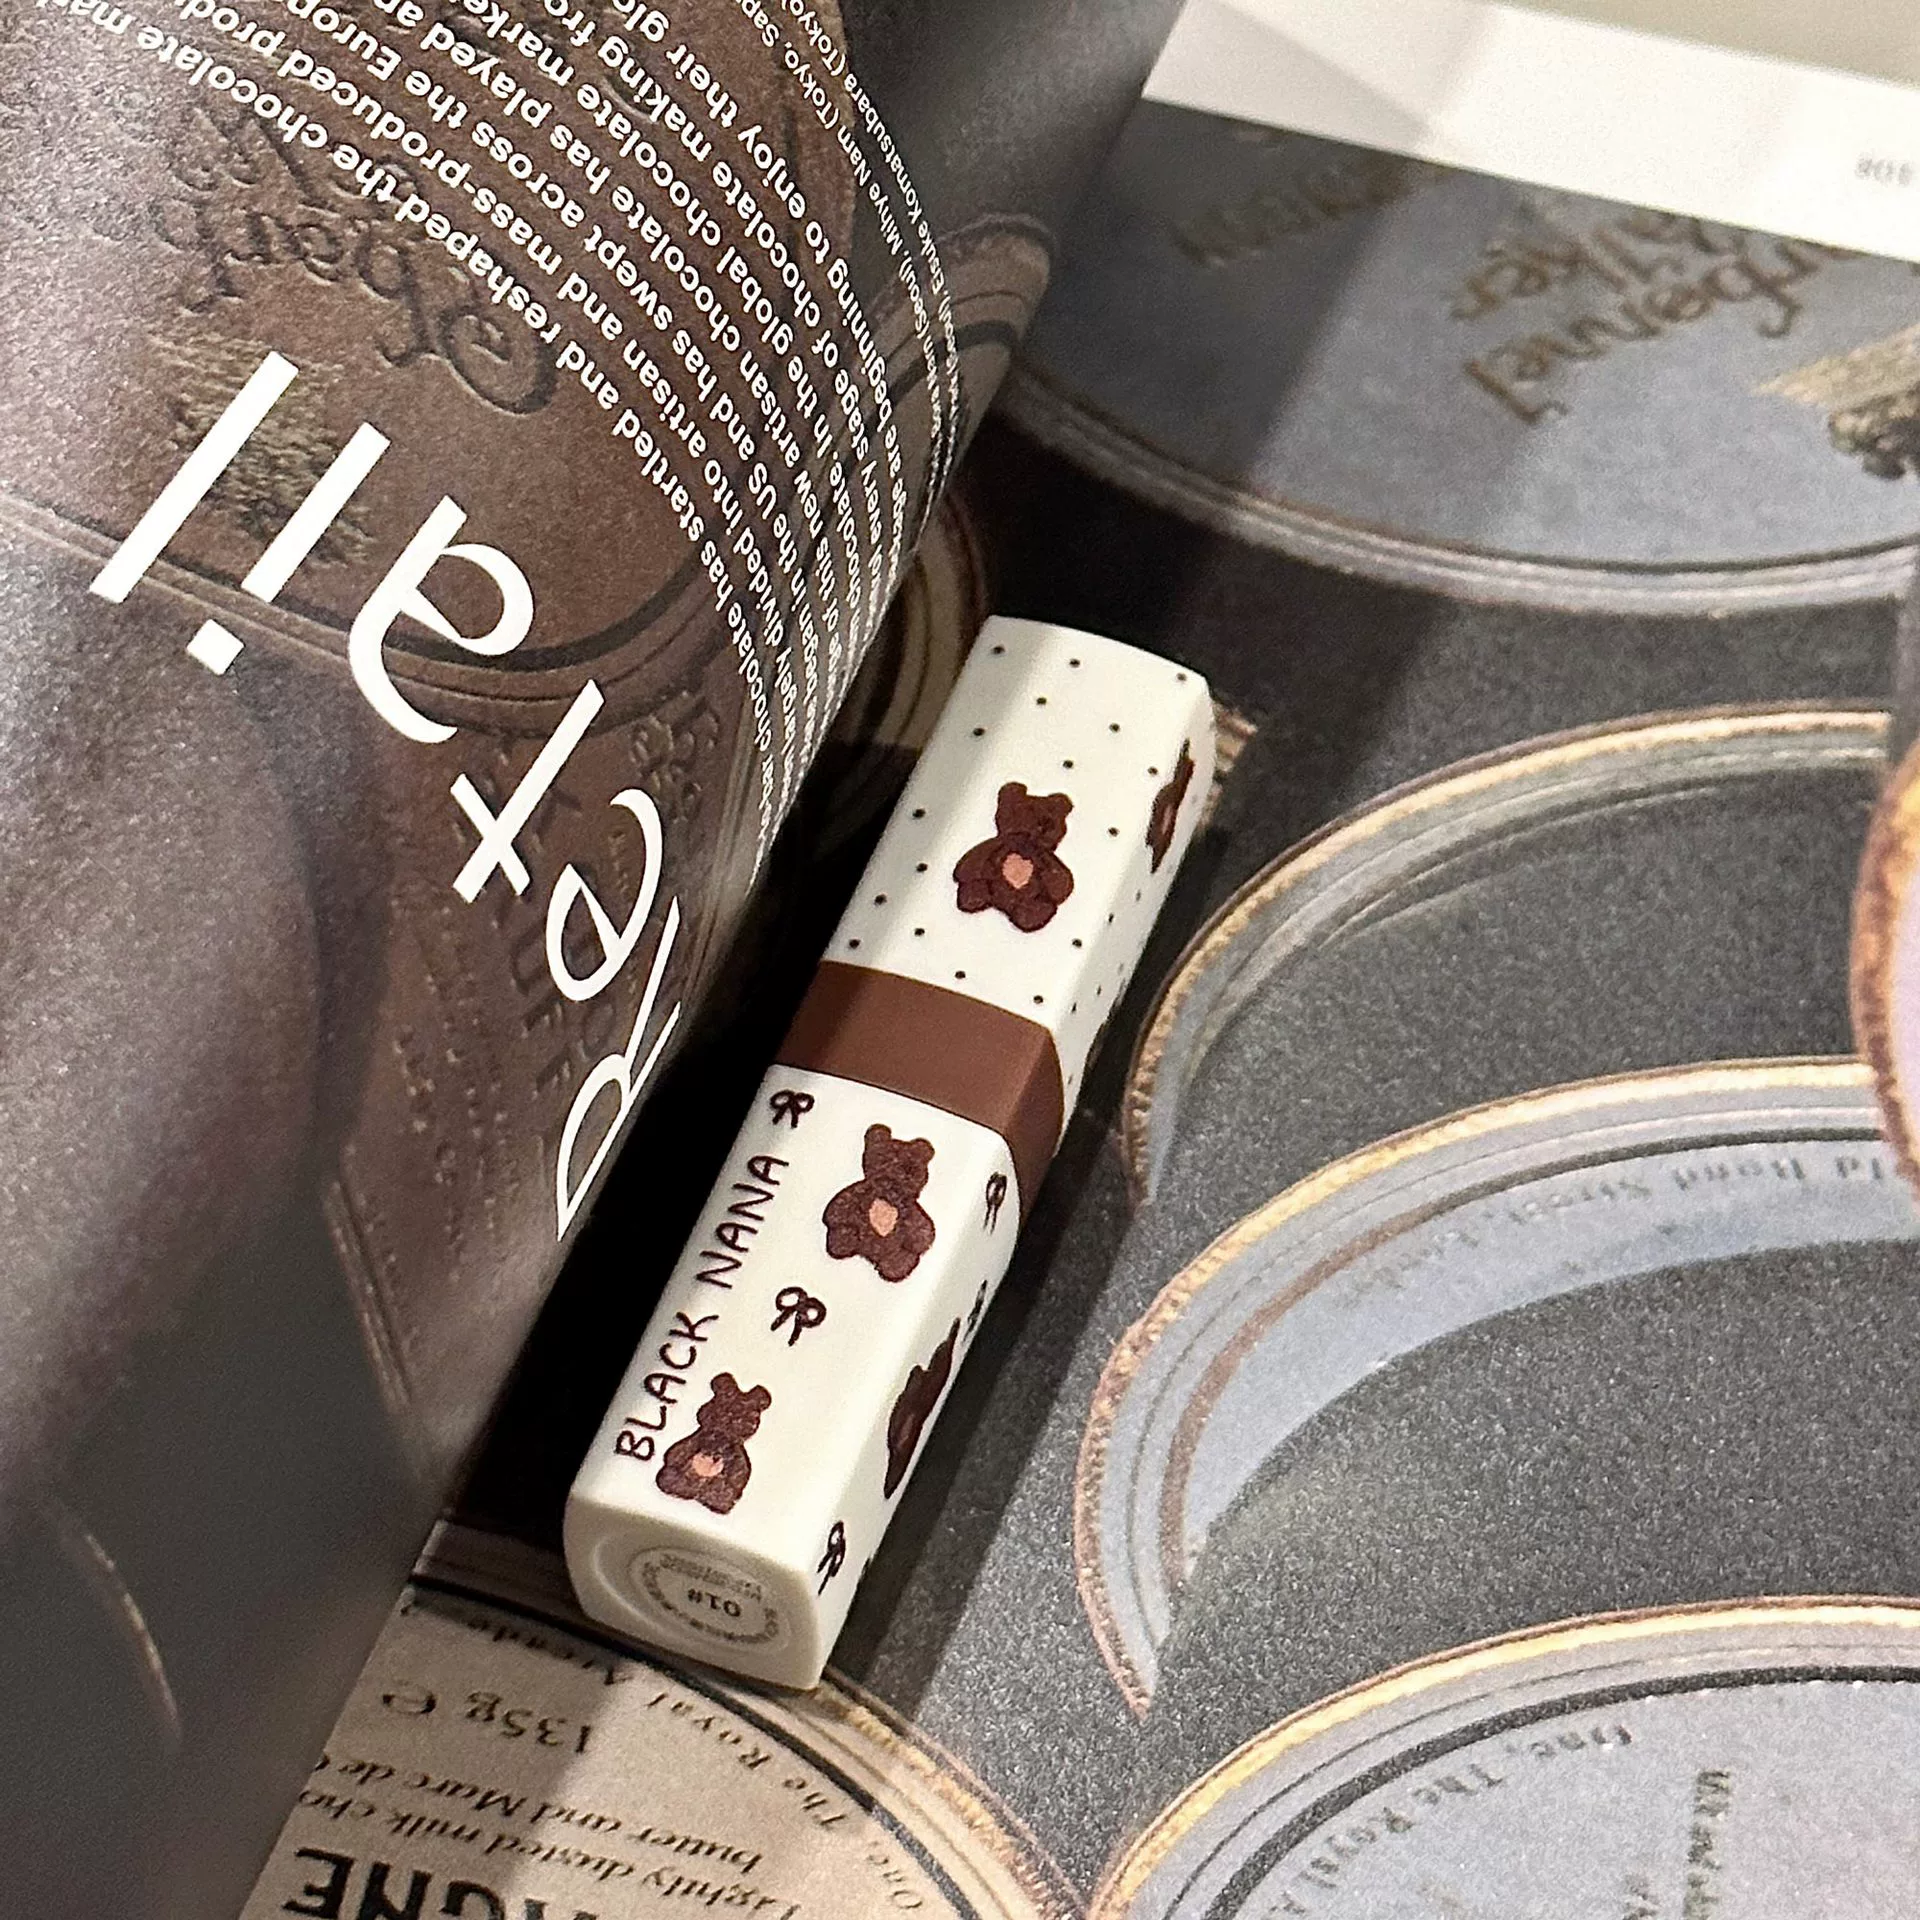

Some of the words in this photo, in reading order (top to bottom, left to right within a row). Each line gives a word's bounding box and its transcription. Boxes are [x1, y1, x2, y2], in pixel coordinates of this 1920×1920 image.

[176, 0, 286, 56] prod
[450, 0, 575, 86] marke
[737, 0, 779, 47] Sap
[138, 26, 327, 147] chocolate
[406, 71, 467, 128] the
[420, 23, 552, 127] played
[598, 36, 711, 161] making
[667, 45, 737, 127] their
[277, 49, 564, 275] mass-produced
[326, 144, 397, 202] the
[472, 122, 584, 227] across
[550, 125, 610, 194] has
[578, 84, 720, 245] chocolate
[738, 126, 805, 218] enjoy
[838, 125, 871, 185] Nam
[845, 74, 922, 224] Komatsubara
[713, 162, 819, 326] chocolate
[806, 222, 829, 264] to
[870, 183, 902, 254] Mihye
[393, 193, 561, 343] reshaped
[584, 225, 672, 330] swept
[613, 186, 739, 350] chocolate
[917, 220, 946, 295] Eisuke
[557, 273, 622, 340] and
[717, 247, 793, 354] global
[556, 341, 618, 409] and
[673, 330, 716, 401] has
[812, 331, 838, 367] of
[827, 259, 891, 432] beginning
[624, 340, 705, 457] artisan
[740, 351, 799, 467] artisan
[789, 356, 817, 418] the
[835, 370, 868, 460] stage
[710, 393, 754, 460] and
[814, 415, 832, 458] In
[885, 425, 900, 478] are
[613, 409, 703, 541] startled
[705, 460, 742, 535] into
[749, 463, 776, 519] US
[794, 471, 823, 538] new
[861, 460, 883, 545] every
[774, 514, 797, 573] the
[828, 450, 862, 609] chocolate.
[701, 541, 733, 611] has
[733, 527, 783, 646] divided
[791, 568, 806, 611] in
[816, 537, 835, 601] this
[822, 598, 838, 632] of
[729, 603, 771, 751] chocolate
[799, 603, 819, 705] began
[775, 647, 799, 755] largely
[90, 351, 681, 1241] Retail
[614, 1311, 719, 1461] BLACK
[696, 1155, 789, 1289] NANA
[464, 1690, 592, 1754] 135g
[646, 1692, 772, 1771] Royal
[338, 1758, 396, 1786] de
[404, 1770, 528, 1818] Marc
[783, 1776, 847, 1828] The
[386, 1806, 481, 1842] milk
[530, 1802, 622, 1832] and
[627, 1827, 762, 1874] butter
[483, 1834, 634, 1881] dusted
